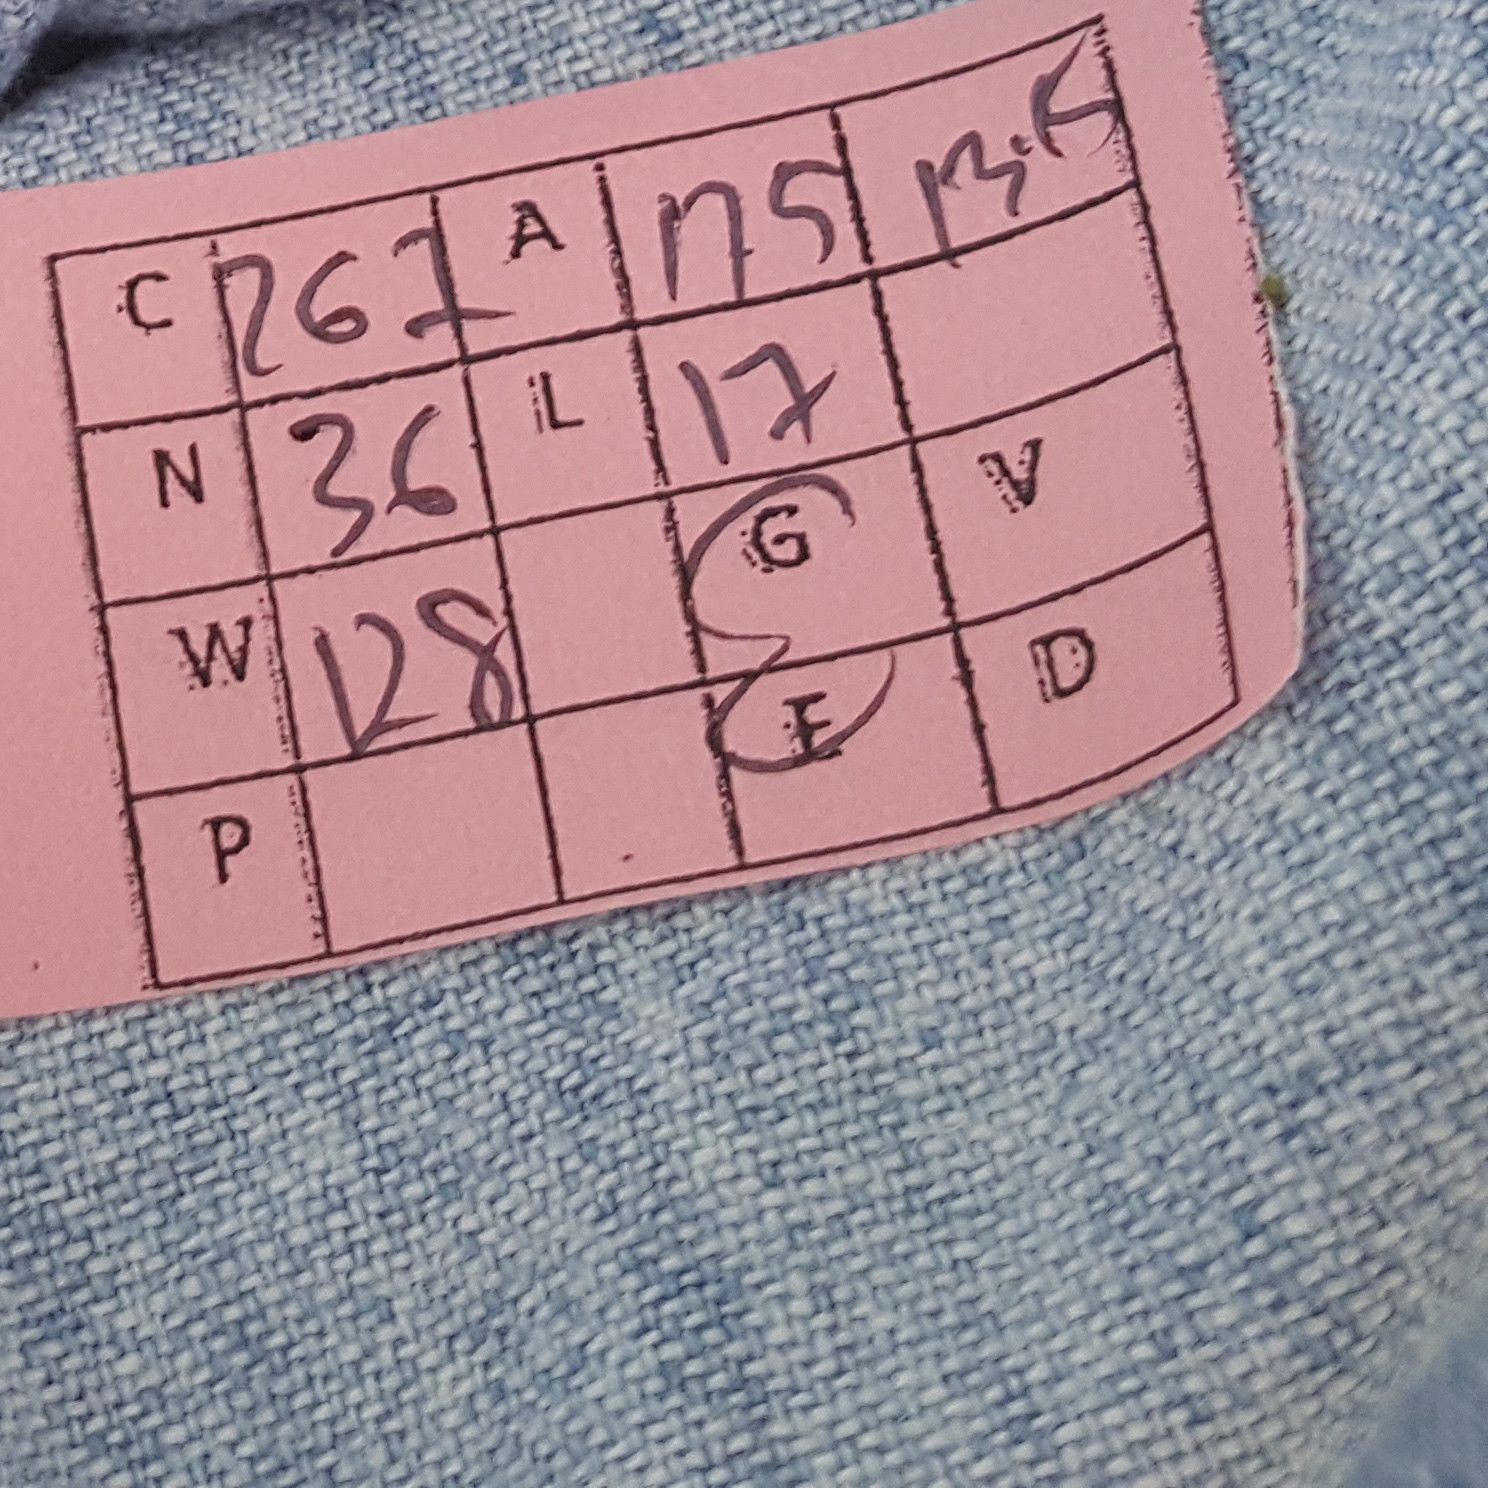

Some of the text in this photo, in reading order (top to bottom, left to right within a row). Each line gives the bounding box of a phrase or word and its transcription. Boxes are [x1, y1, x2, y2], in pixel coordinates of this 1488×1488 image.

[508, 200, 566, 263] A
[122, 271, 173, 331] C
[531, 370, 584, 432] L
[678, 343, 837, 464] 17
[152, 441, 206, 508] N
[288, 405, 458, 558] 36
[977, 437, 1044, 514] V
[746, 503, 811, 573] G
[168, 614, 253, 689] W
[313, 588, 513, 757] 128
[1027, 627, 1096, 703] D
[782, 690, 843, 760] E
[201, 814, 251, 885] P
